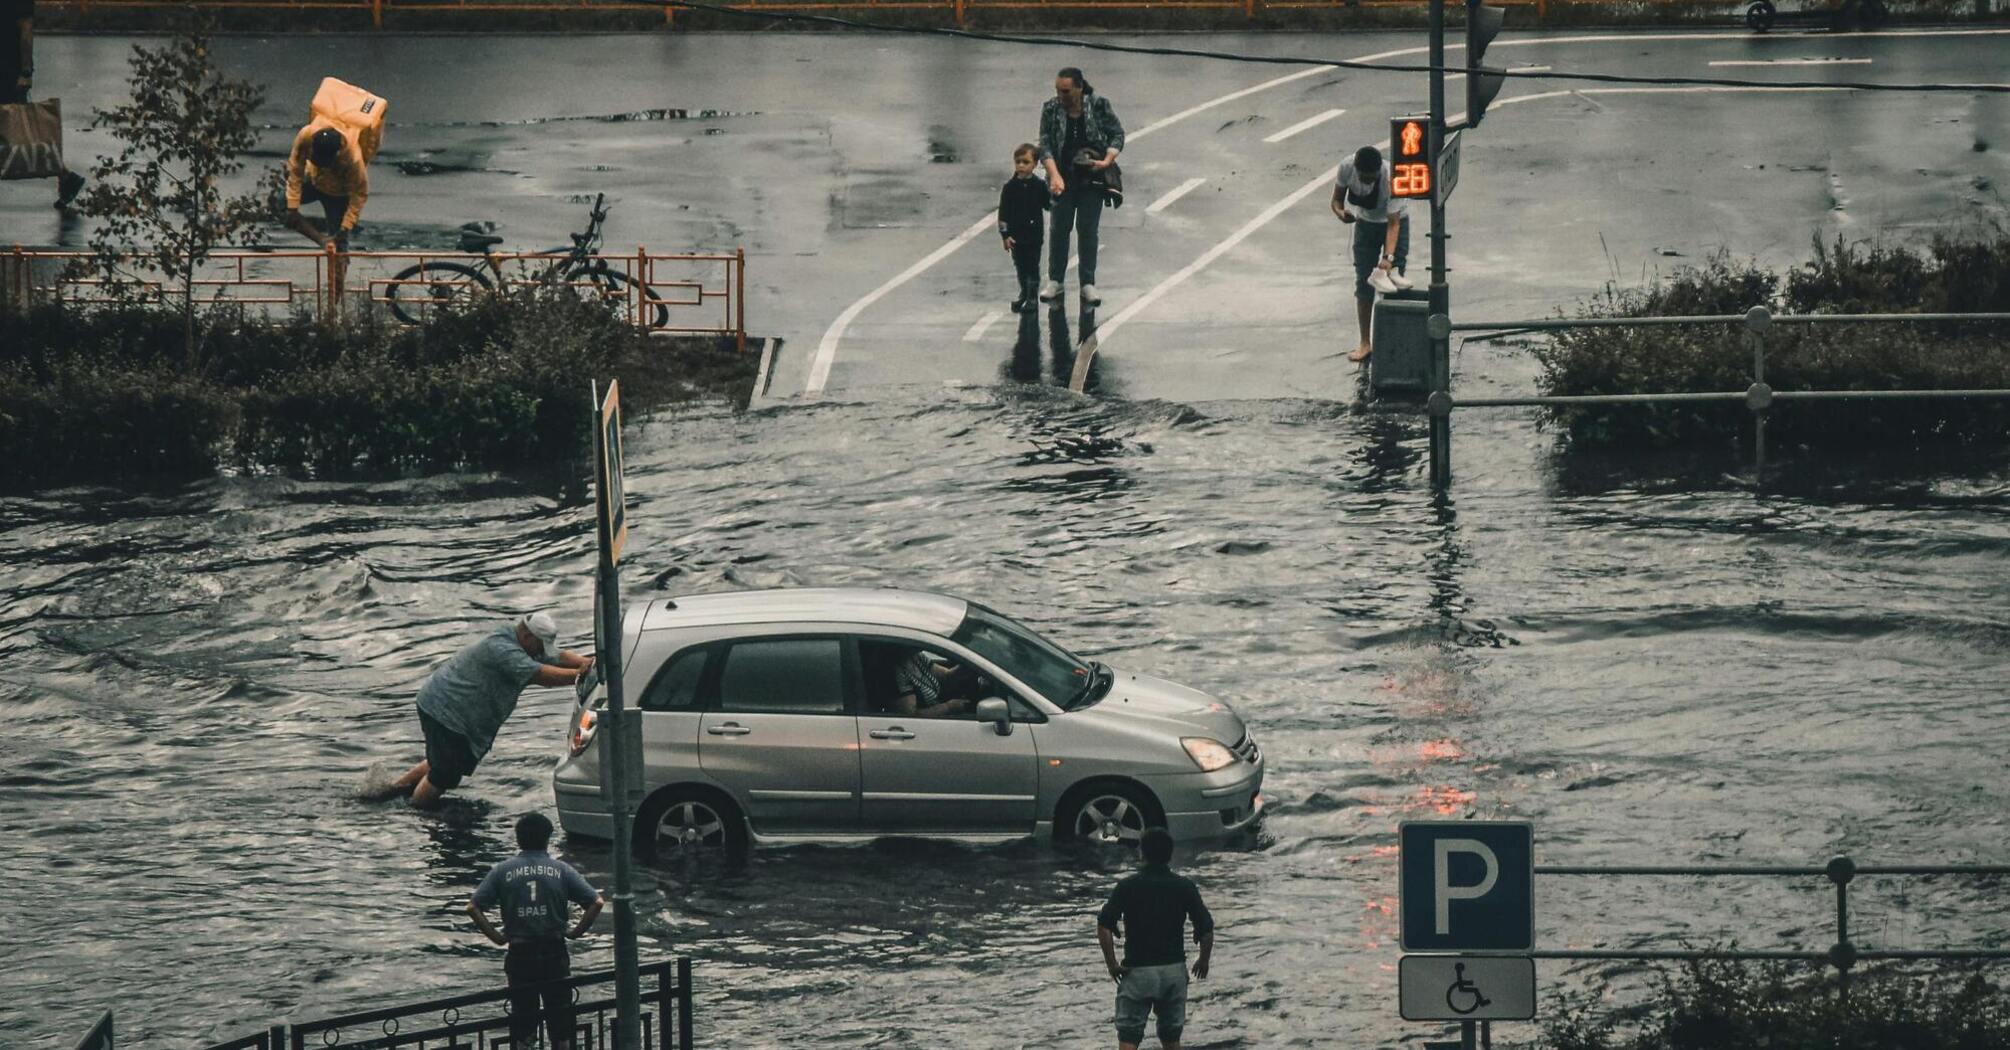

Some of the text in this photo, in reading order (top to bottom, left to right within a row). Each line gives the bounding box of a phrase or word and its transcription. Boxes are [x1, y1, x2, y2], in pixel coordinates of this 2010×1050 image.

[1393, 164, 1430, 195] 28
[505, 865, 561, 881] DIMENSION
[526, 880, 537, 901] 1
[1434, 838, 1499, 935] P
[517, 905, 548, 917] SPAS
